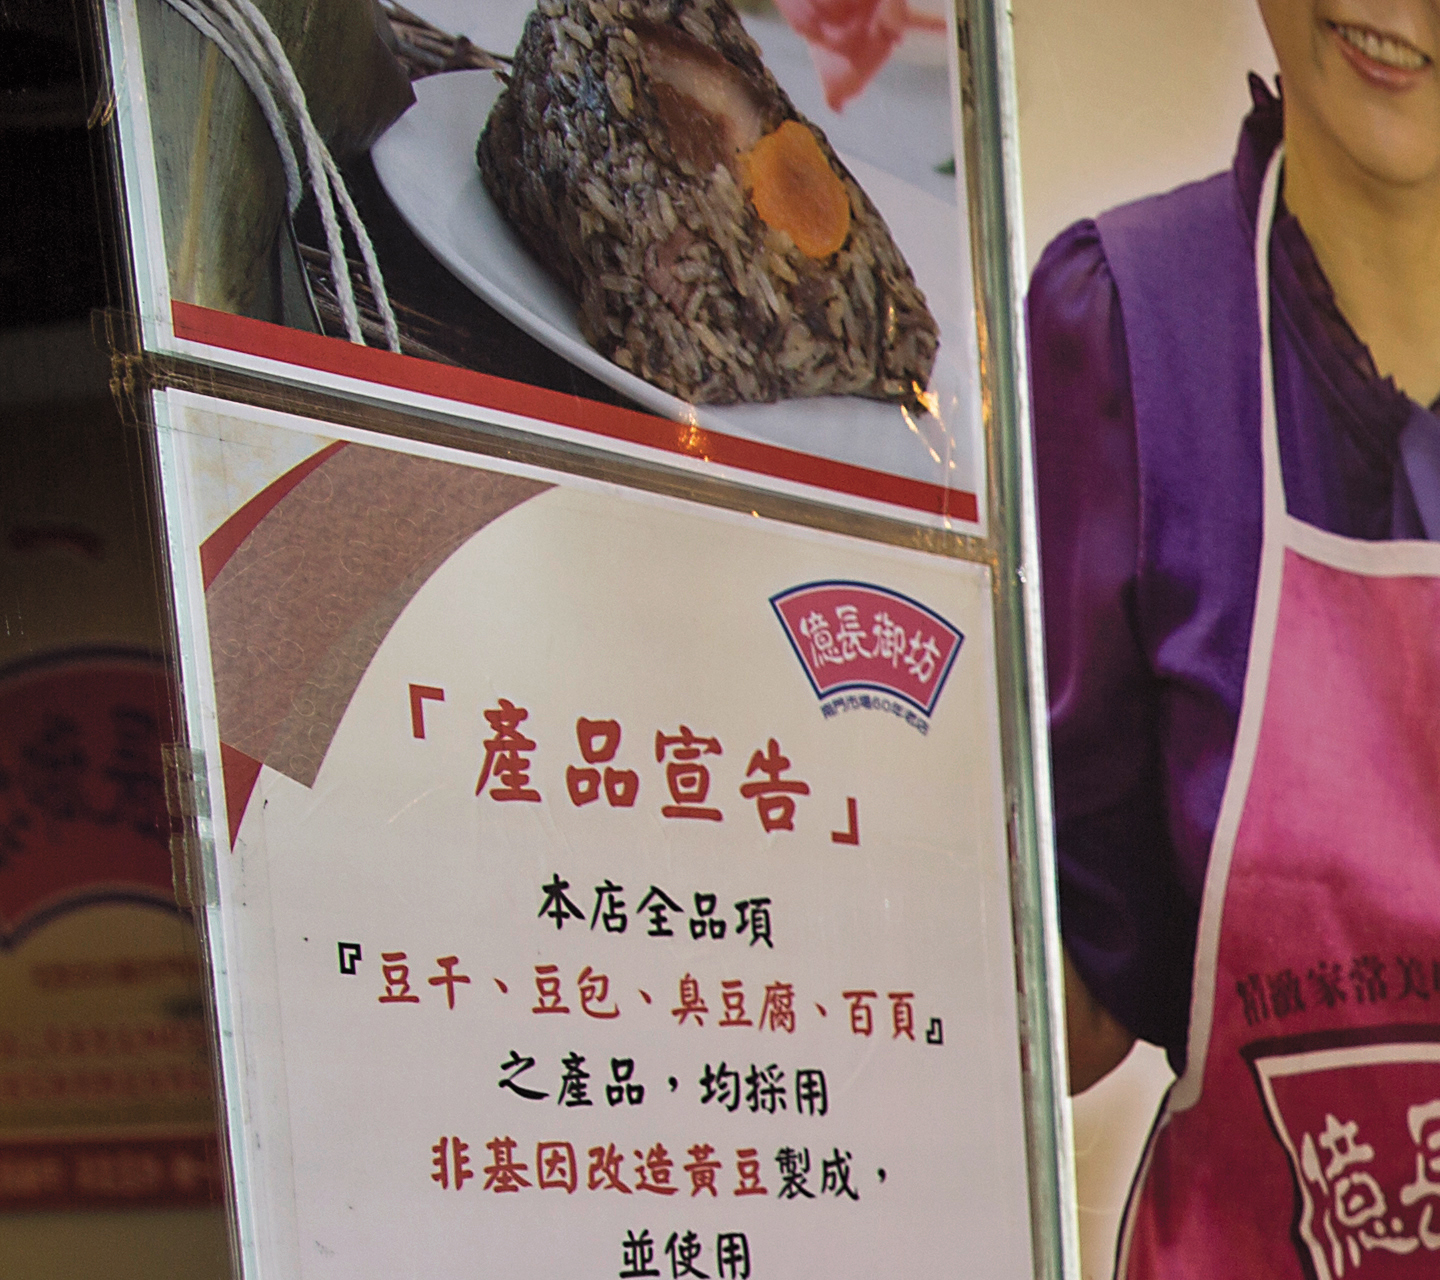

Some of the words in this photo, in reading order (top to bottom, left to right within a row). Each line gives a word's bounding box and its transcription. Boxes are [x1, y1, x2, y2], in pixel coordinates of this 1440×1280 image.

[800, 604, 942, 684] 億長御坊
[408, 684, 861, 846] 「產品宣告」
[537, 873, 775, 949] 本店全品項
[338, 941, 945, 1047] 『豆干、豆包、臭豆腐、百頁』
[497, 1049, 831, 1119] 之產品，均採用
[430, 1136, 890, 1203] 非基因改造黃豆製成，
